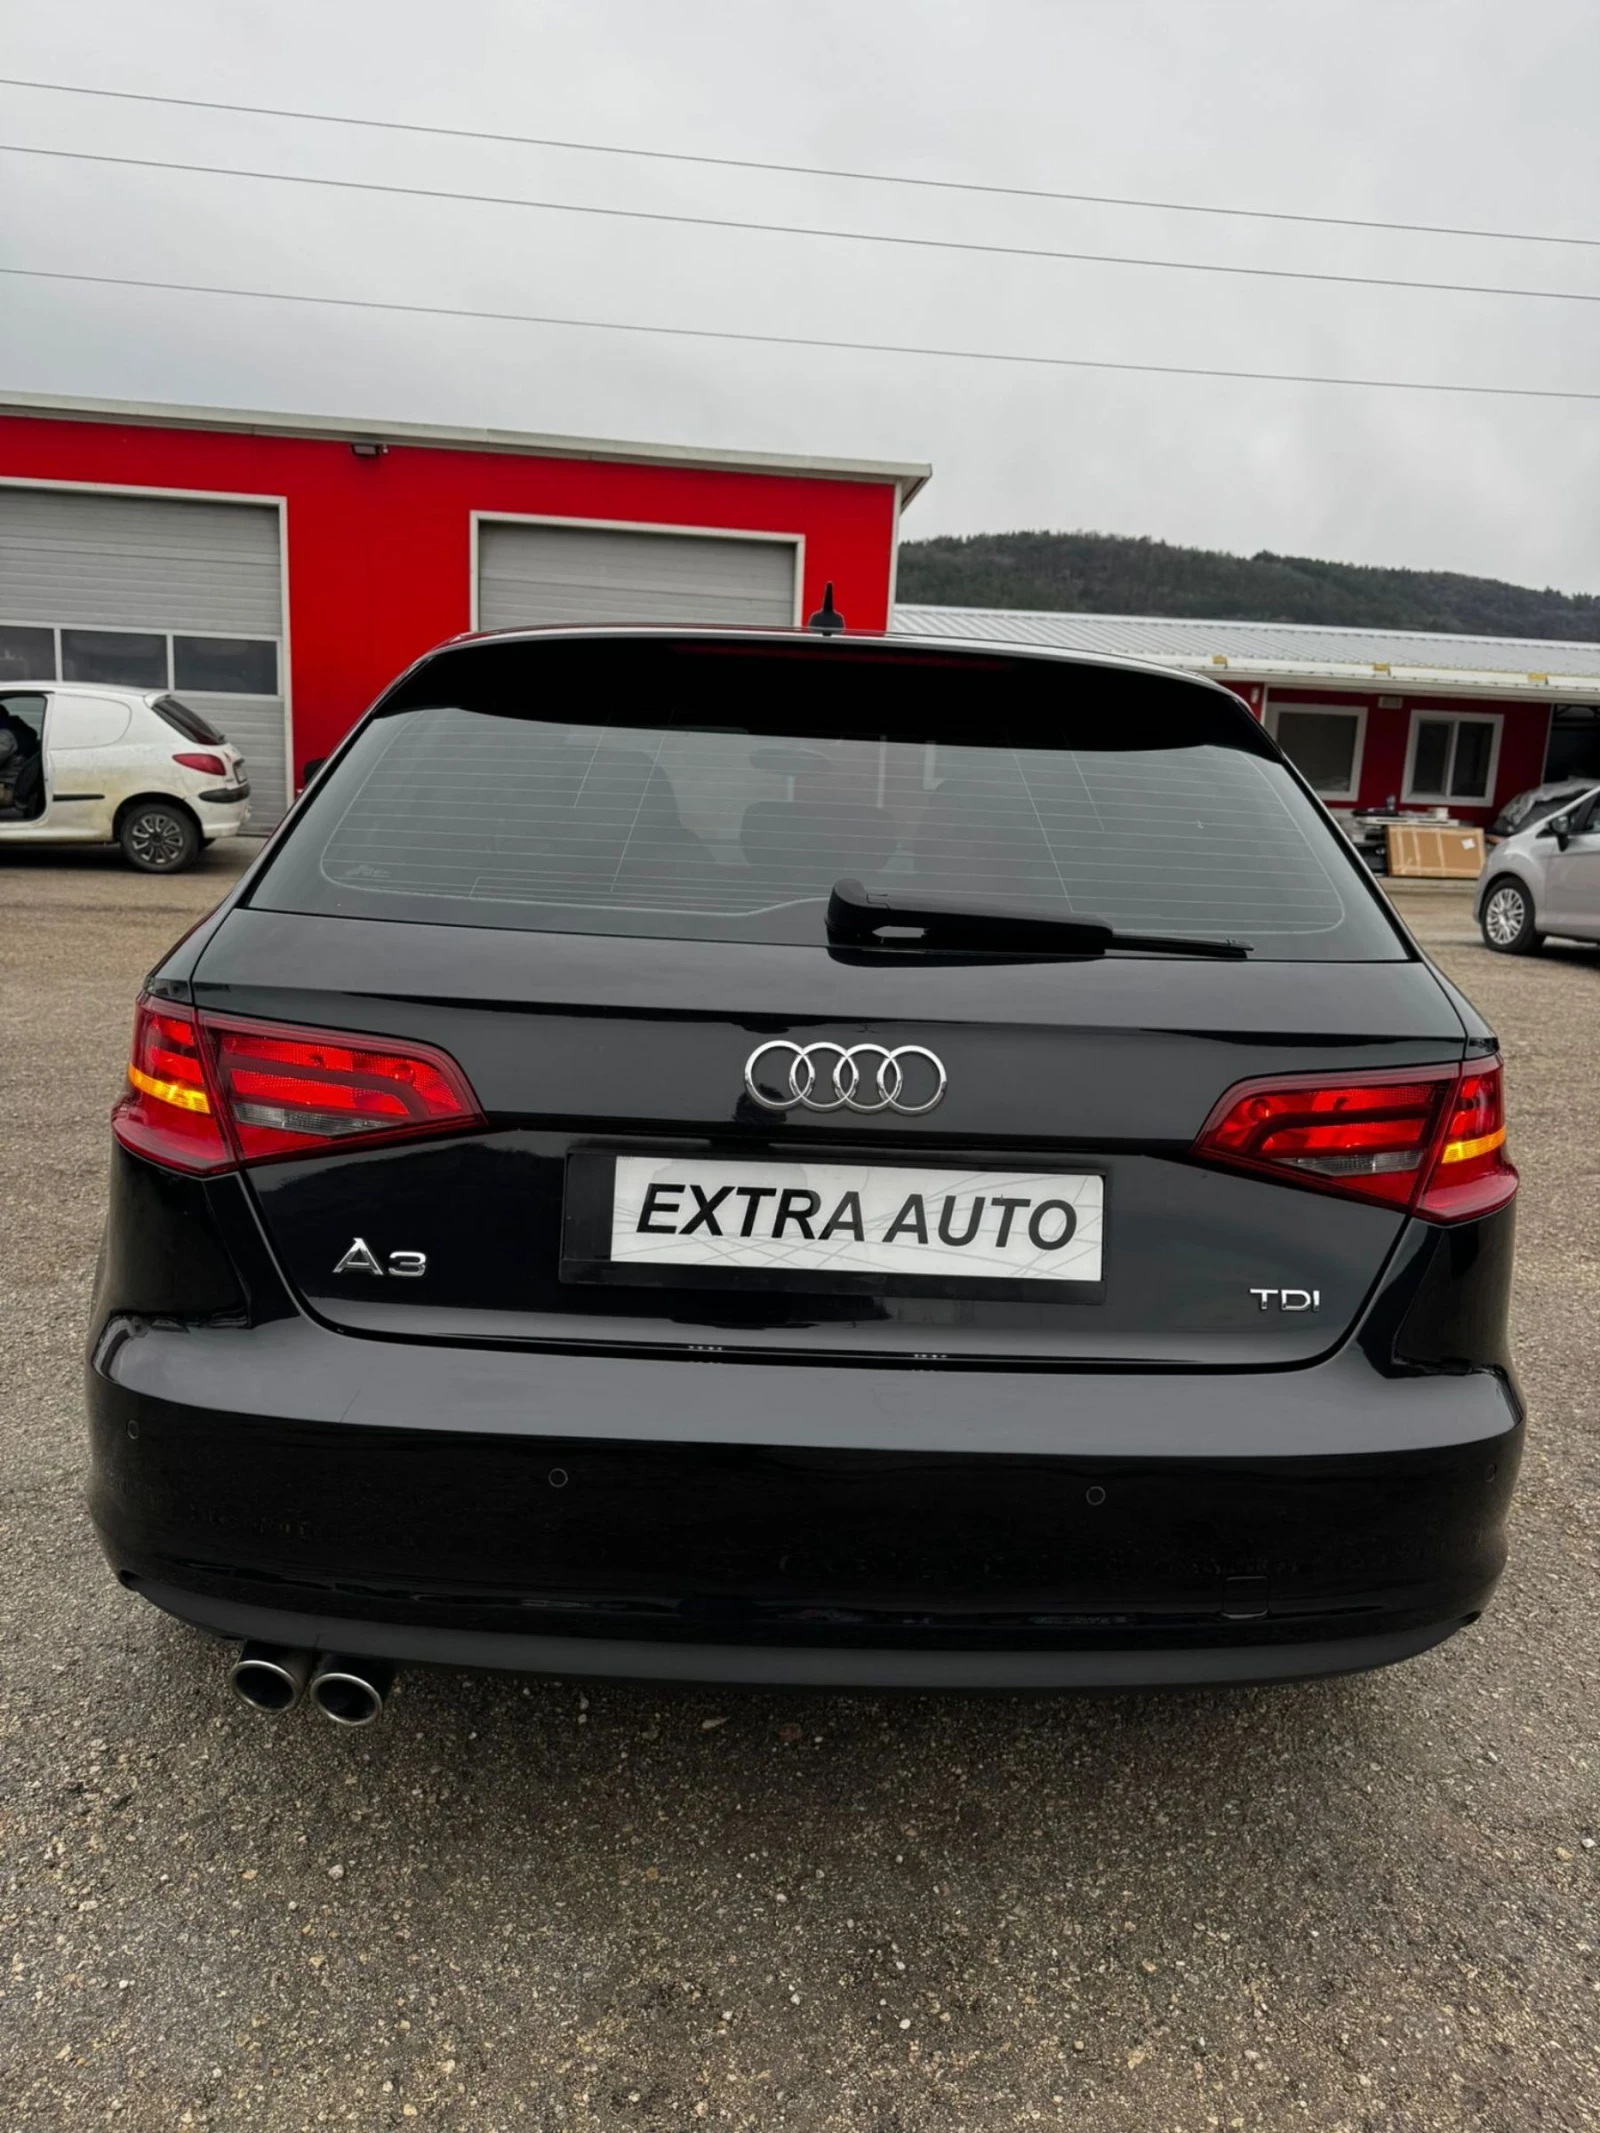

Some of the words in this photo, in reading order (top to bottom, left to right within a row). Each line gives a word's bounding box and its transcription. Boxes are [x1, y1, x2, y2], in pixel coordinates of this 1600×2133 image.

[636, 1183, 865, 1241] EXTRA
[882, 1193, 1079, 1251] AUTO
[332, 1237, 427, 1277] A3
[1249, 1288, 1320, 1312] TDI
